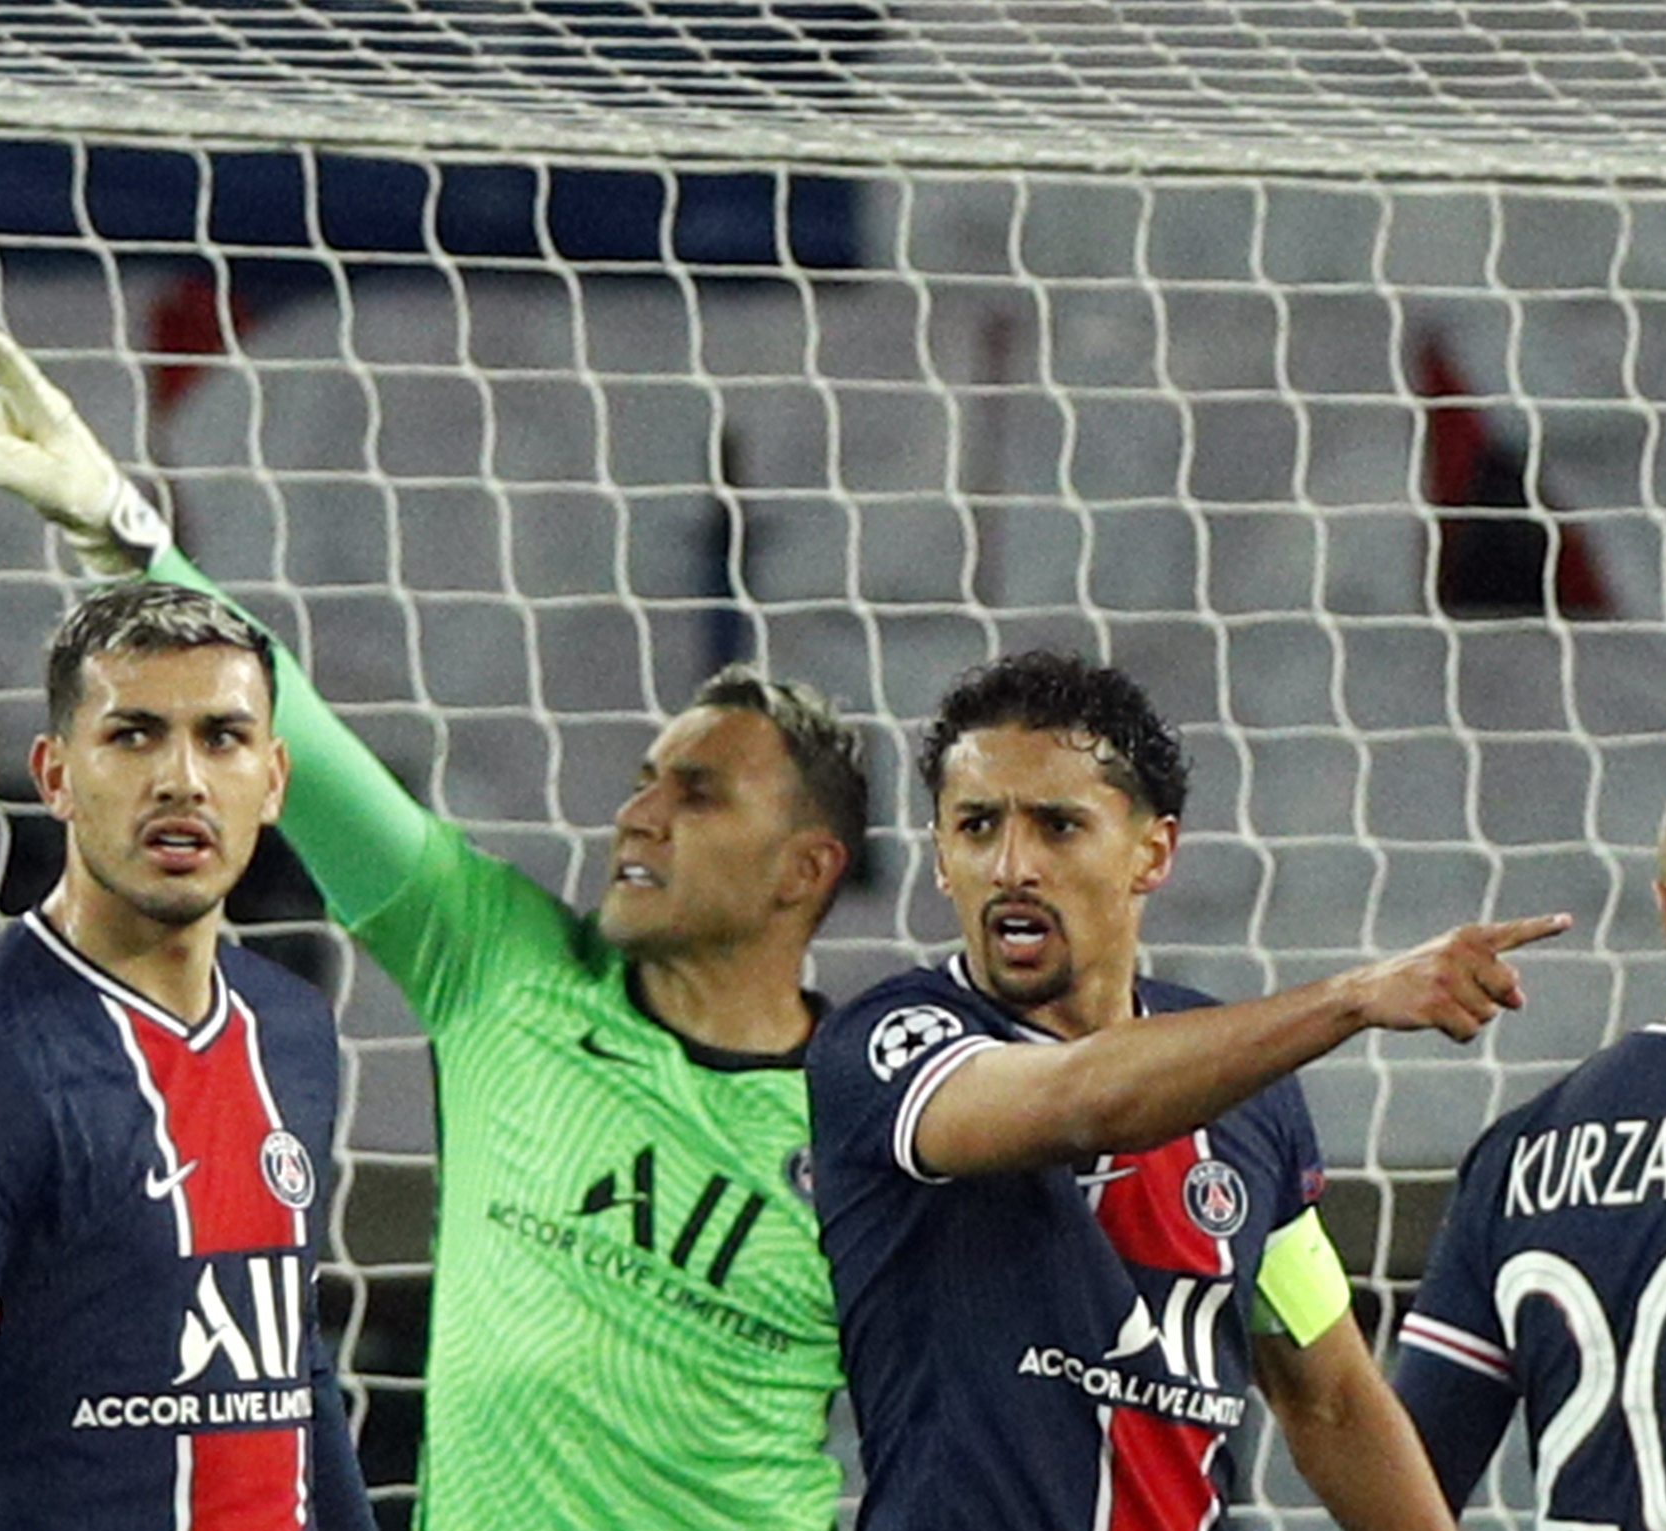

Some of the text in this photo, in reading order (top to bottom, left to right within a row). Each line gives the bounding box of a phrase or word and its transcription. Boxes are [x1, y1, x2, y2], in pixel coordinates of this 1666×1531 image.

[487, 1204, 577, 1252] ACCOR
[584, 1249, 652, 1288] LIVE
[72, 1394, 201, 1428] ACCOR
[208, 1391, 266, 1424] LIVE
[1018, 1345, 1123, 1400] ACCOR
[1125, 1374, 1188, 1416] LIVE
